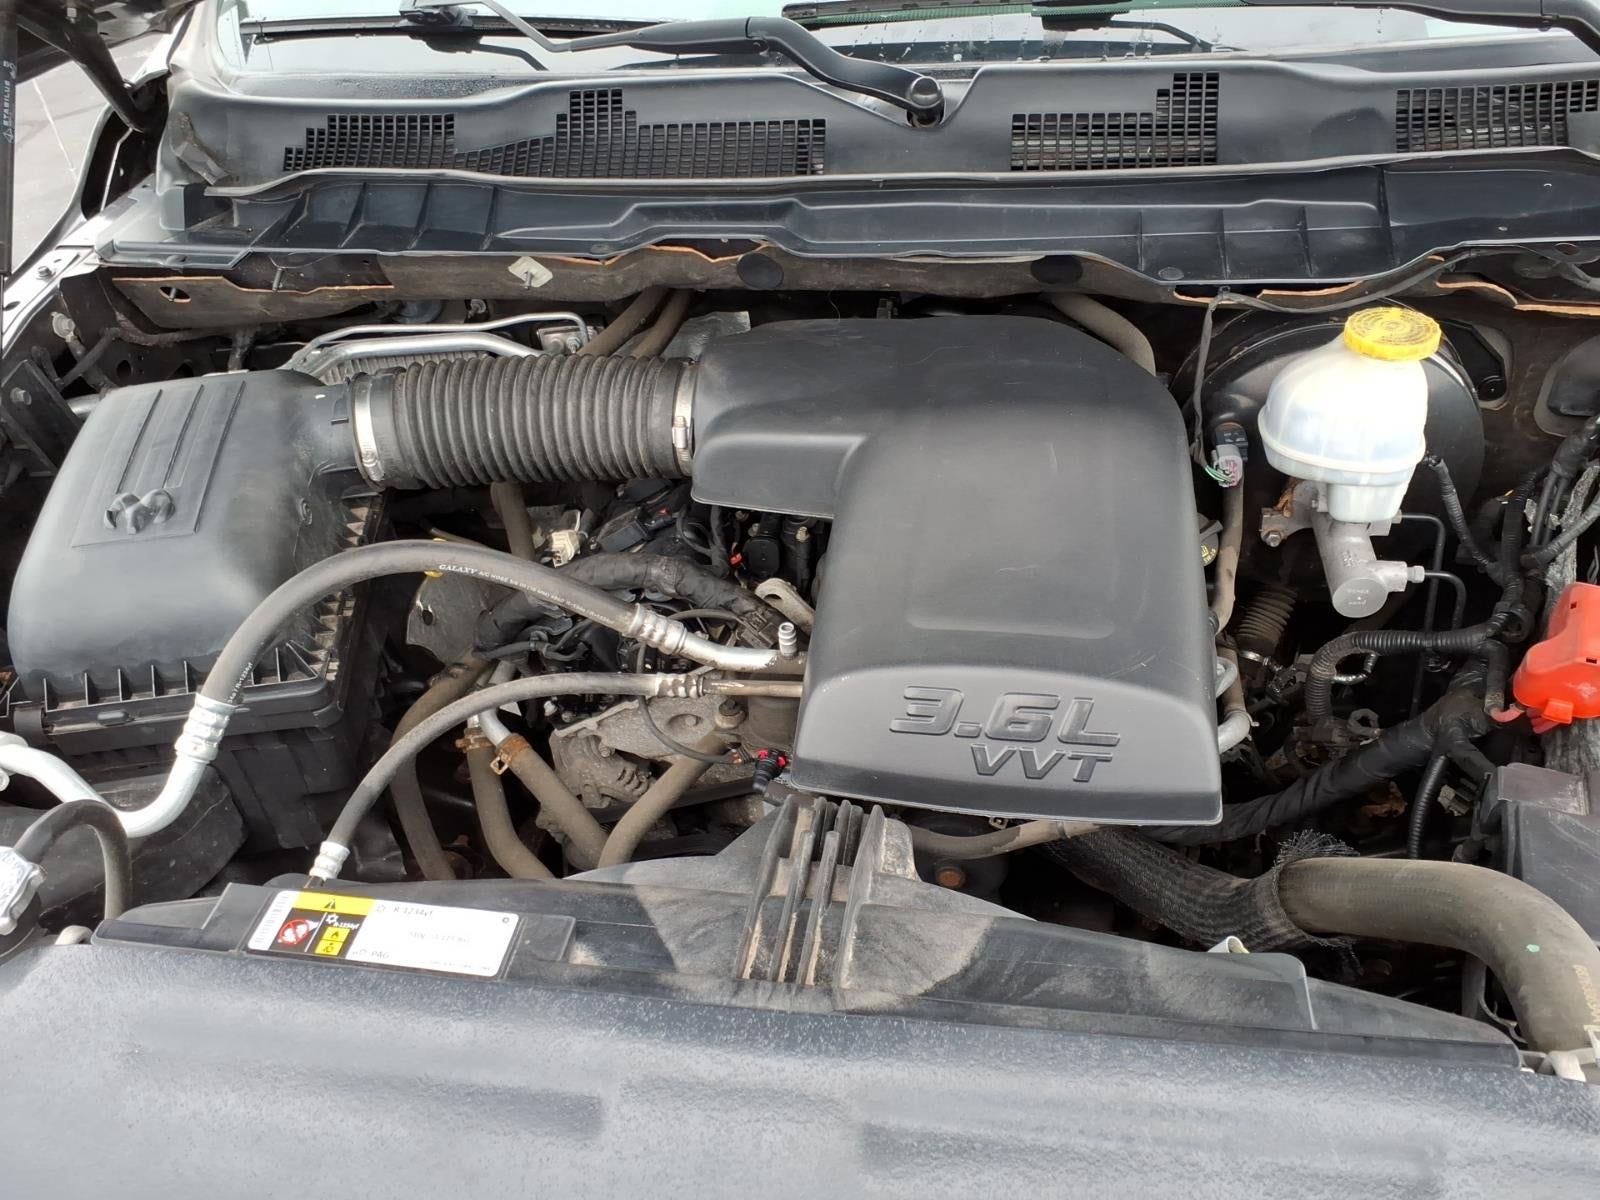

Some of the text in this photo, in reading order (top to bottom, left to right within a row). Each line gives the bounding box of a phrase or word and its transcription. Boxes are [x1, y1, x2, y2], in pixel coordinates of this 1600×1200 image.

[439, 563, 478, 574] GALAXY
[490, 574, 509, 582] HOSE
[889, 686, 1121, 746] 3.6L
[970, 743, 1113, 782] VVT
